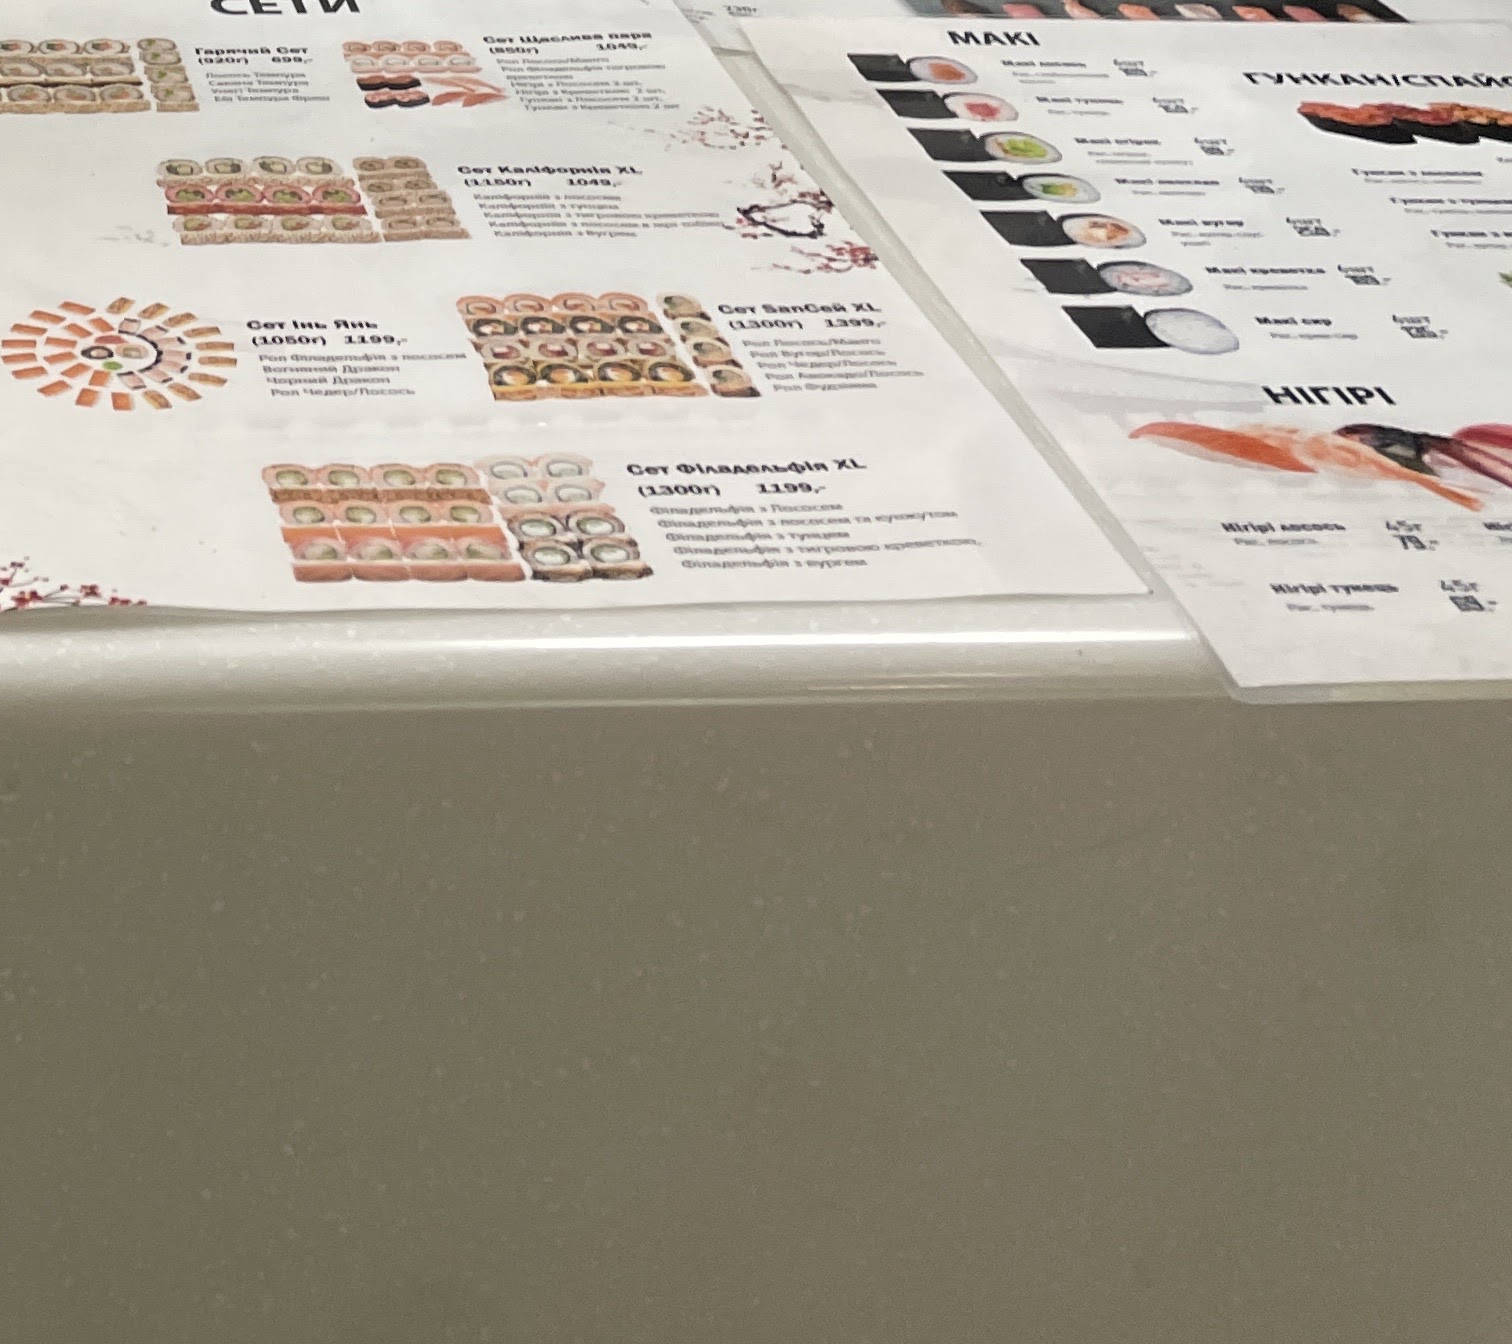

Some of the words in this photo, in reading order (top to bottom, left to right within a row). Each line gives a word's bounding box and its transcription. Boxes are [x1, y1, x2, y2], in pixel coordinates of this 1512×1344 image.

[946, 30, 1041, 46] МАКІ
[497, 165, 612, 176] Каліфорнія
[246, 319, 287, 330] Сет
[1261, 385, 1398, 406] НІГІРІ
[626, 463, 669, 476] Сет
[676, 461, 829, 474] Філадельфія
[833, 458, 868, 470] XL
